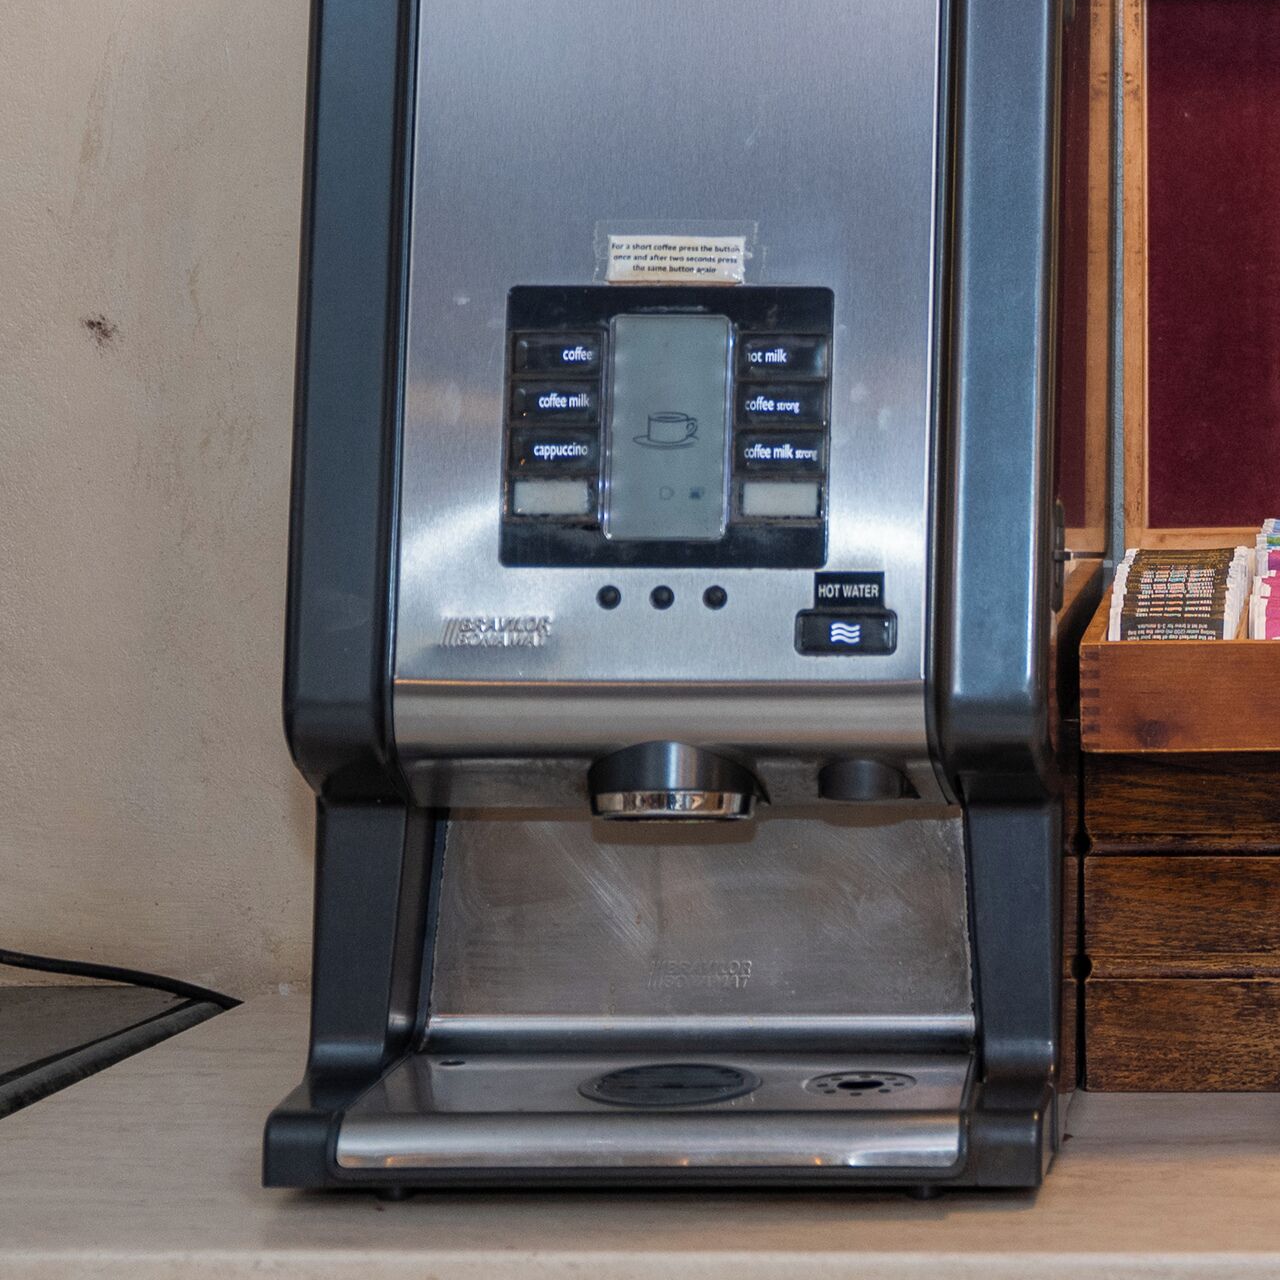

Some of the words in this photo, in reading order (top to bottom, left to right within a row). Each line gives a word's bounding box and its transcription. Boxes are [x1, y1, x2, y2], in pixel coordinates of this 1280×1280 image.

[632, 243, 652, 251] short
[700, 244, 713, 252] the
[650, 254, 667, 262] after
[686, 255, 716, 263] seconds
[717, 257, 738, 265] press
[632, 264, 645, 272] the
[669, 265, 695, 273] button
[562, 346, 593, 361] coffee
[765, 348, 787, 363] milk
[538, 392, 567, 408] coffee
[568, 392, 590, 408] milk
[745, 396, 775, 411] coffee
[776, 401, 800, 414] strong
[533, 442, 588, 460] cappuccino
[744, 443, 772, 459] coffee
[773, 443, 793, 459] milk
[795, 448, 818, 461] strong
[818, 584, 841, 598] HOT
[842, 584, 880, 598] WATER
